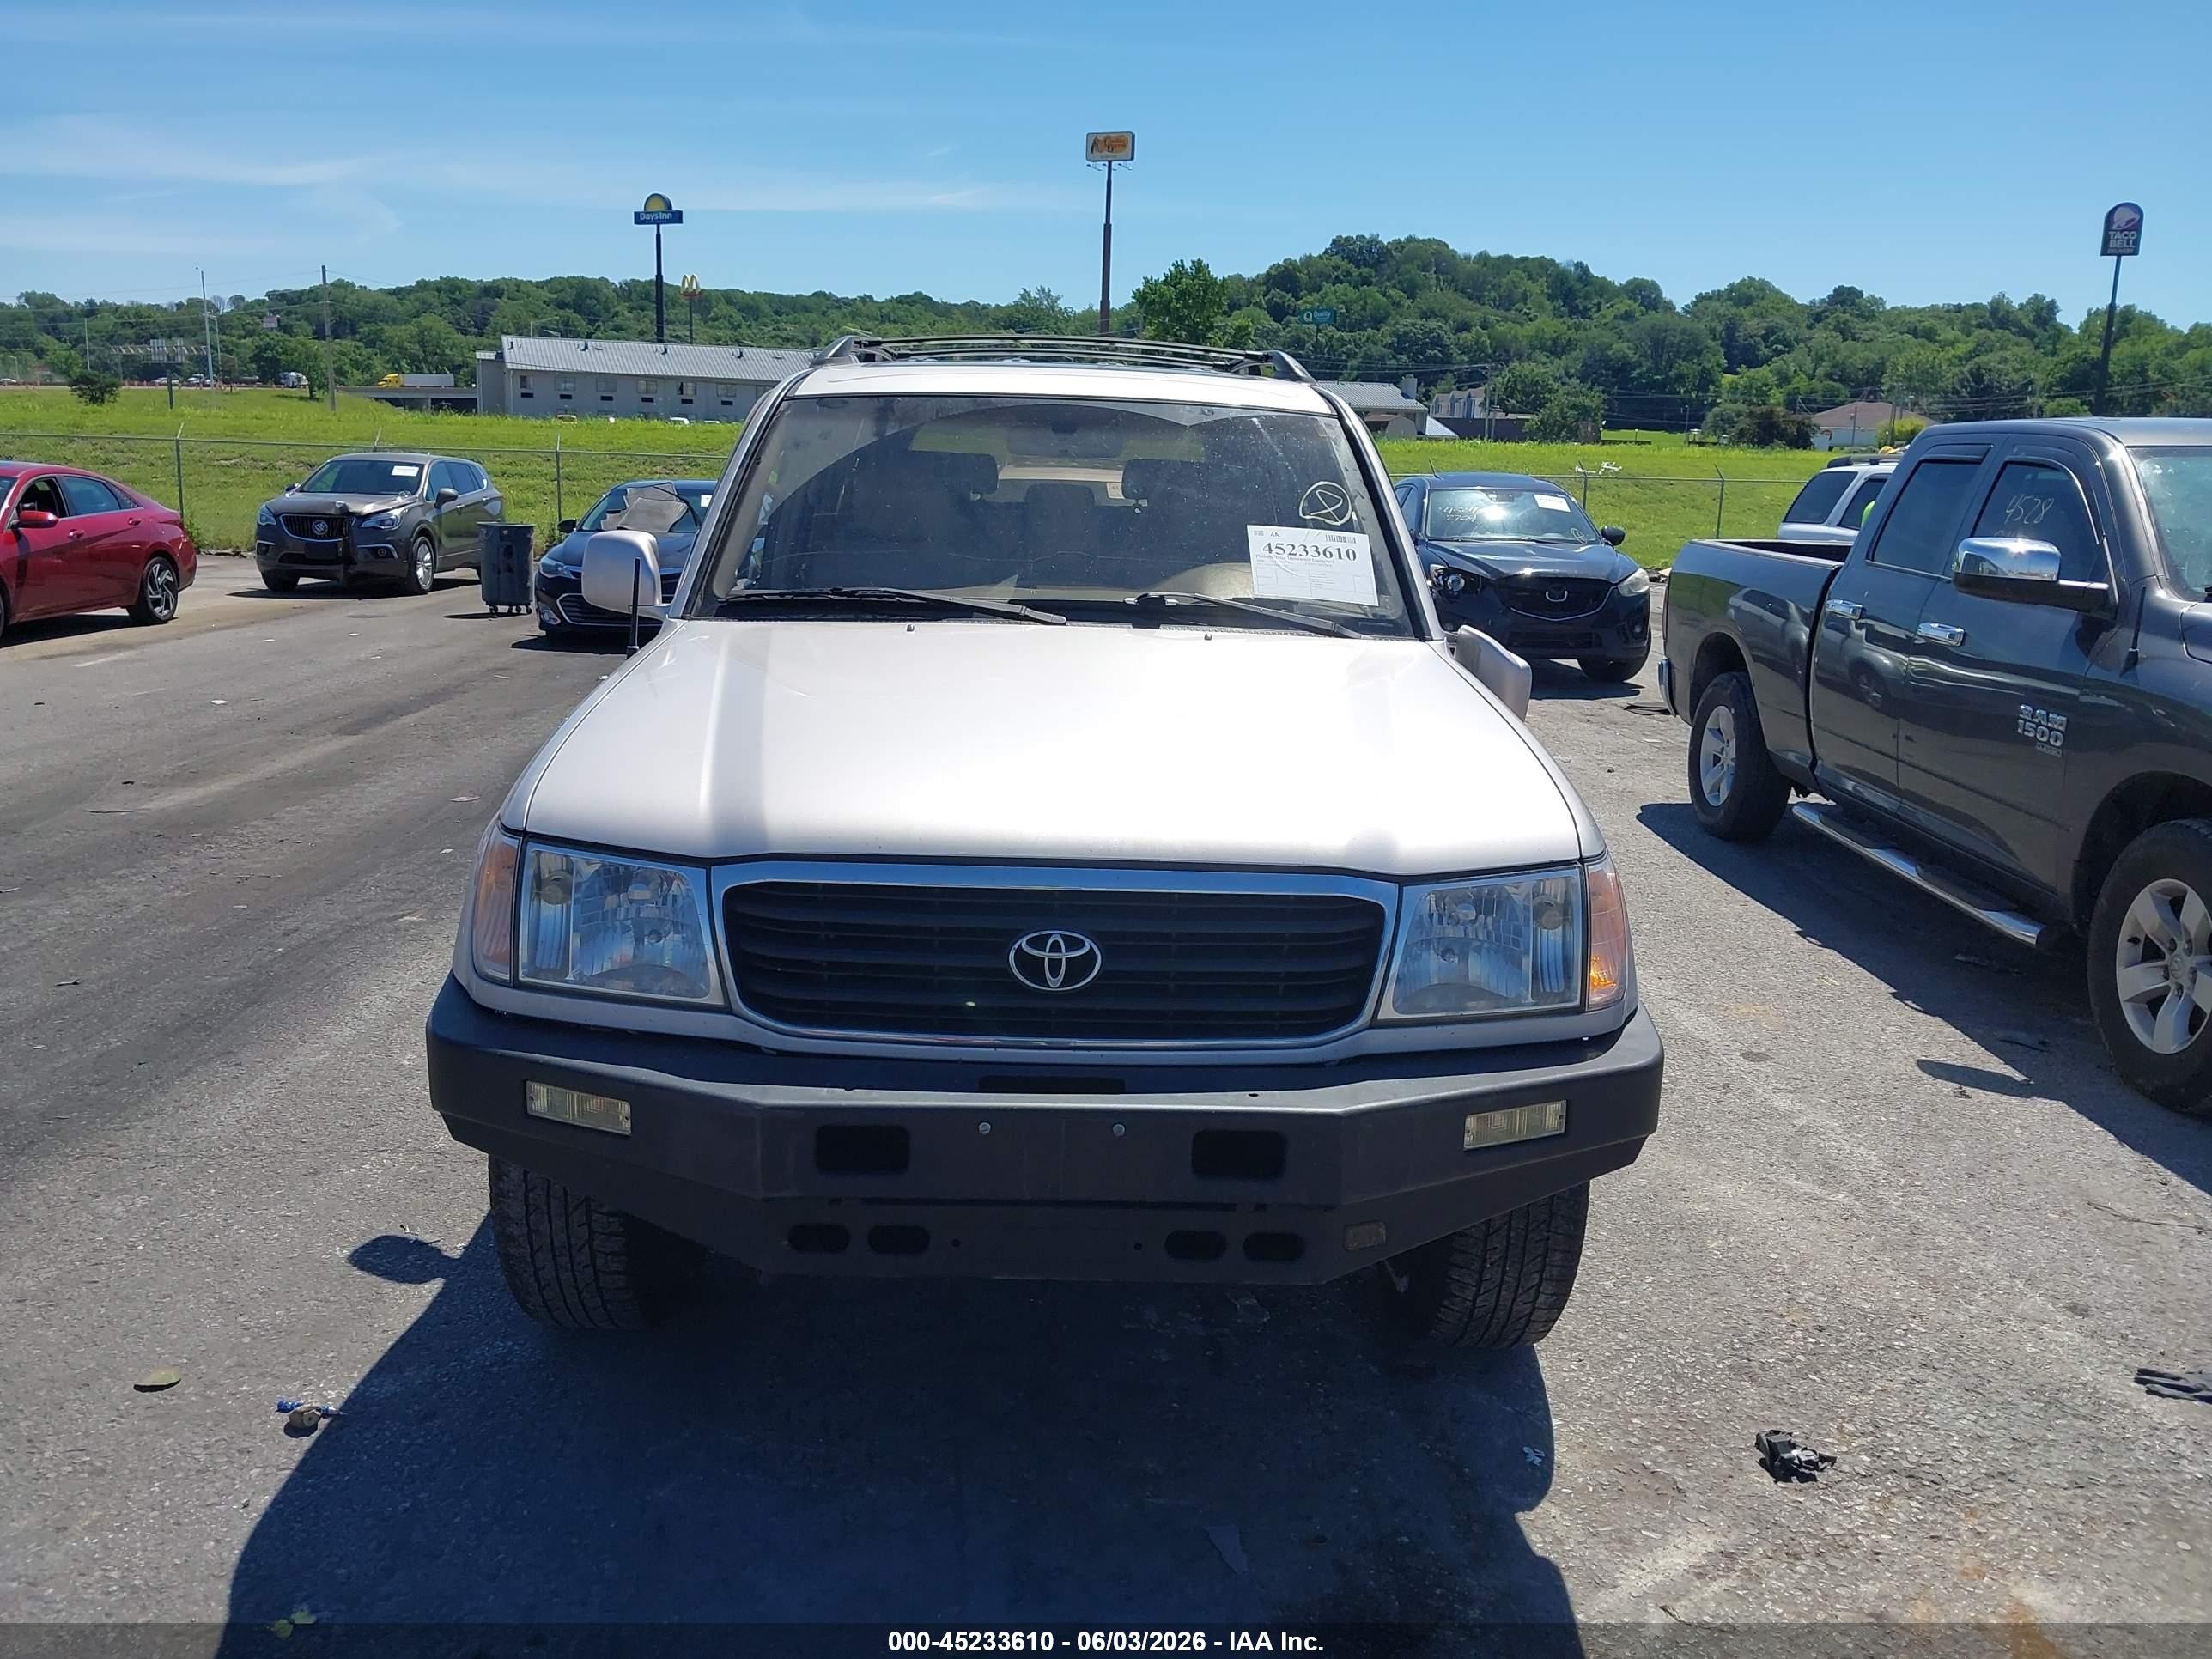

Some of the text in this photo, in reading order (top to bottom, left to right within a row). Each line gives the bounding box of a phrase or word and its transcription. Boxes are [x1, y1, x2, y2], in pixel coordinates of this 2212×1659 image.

[640, 212, 659, 221] Days
[2108, 231, 2137, 240] TACO
[2109, 240, 2136, 248] BELL
[1262, 541, 1357, 562] 45233610
[2019, 704, 2068, 732] RAM
[2017, 720, 2064, 747] 1500
